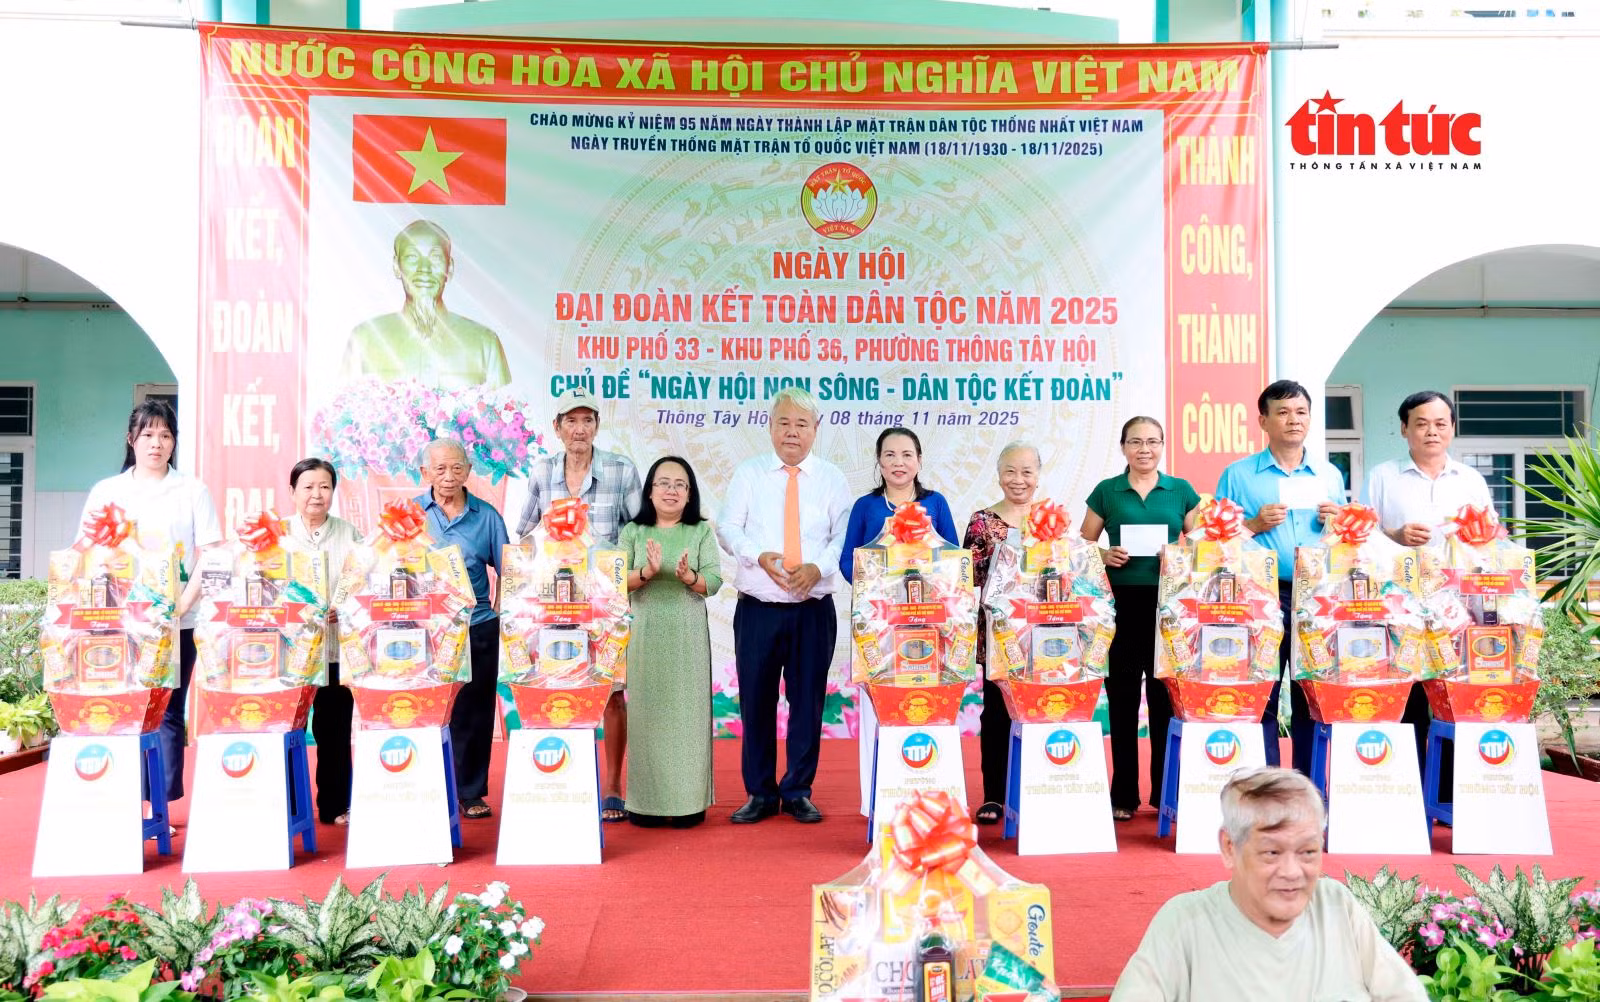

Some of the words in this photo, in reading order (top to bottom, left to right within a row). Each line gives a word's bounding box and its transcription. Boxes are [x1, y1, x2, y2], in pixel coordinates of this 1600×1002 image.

[229, 38, 356, 80] NƯỚC
[371, 44, 496, 89] CỘNG
[511, 47, 602, 88] HÒA
[616, 52, 676, 90] XÃ
[691, 54, 763, 97] HỘI
[779, 51, 867, 93] CHỦ
[883, 54, 1018, 94] NGHĨA
[1032, 54, 1123, 101] VIỆT
[1137, 59, 1239, 94] NAM
[530, 113, 568, 127] CHÀO
[572, 112, 614, 128] MỪNG
[617, 111, 635, 129] KỶ
[639, 114, 676, 132] NIỆM
[679, 118, 696, 131] 95
[700, 115, 732, 131] NĂM
[736, 115, 774, 132] NGÀY
[777, 116, 823, 133] THÀNH
[826, 116, 851, 135] LẬP
[856, 117, 886, 136] MẶT
[889, 117, 925, 136] TRẬN
[929, 117, 960, 133] DÂN
[962, 117, 987, 136] TỘC
[991, 114, 1036, 133] THỐNG
[1040, 115, 1075, 133] NHẤT
[1079, 117, 1109, 135] VIỆT
[1112, 119, 1144, 132] NAM
[571, 134, 608, 150] NGÀY
[670, 134, 716, 153] THỐNG
[720, 137, 750, 155] MẶT
[754, 137, 791, 156] TRẬN
[794, 136, 812, 153] TỔ
[815, 136, 851, 156] QUỐC
[856, 138, 884, 157] VIỆT
[889, 141, 920, 155] NAM
[924, 141, 1008, 157] (18/11/1930
[1020, 142, 1103, 157] 18/11/2025)
[1177, 125, 1255, 186] THÀNH
[773, 247, 848, 280] NGÀY
[858, 246, 905, 286] HỘI
[1180, 213, 1253, 281] CÔNG,
[212, 289, 294, 353] ĐOÀN
[555, 292, 604, 328] ĐẠI
[613, 287, 692, 323] ĐOÀN
[702, 284, 754, 323] KẾT
[762, 289, 836, 324] TOÀN
[846, 289, 905, 324] DÂN
[913, 290, 967, 331] TỘC
[976, 290, 1041, 325] NĂM
[1050, 297, 1118, 325] 2025
[577, 335, 620, 360] KHU
[626, 329, 668, 360] PHỐ
[675, 337, 700, 361] 33
[721, 337, 763, 361] KHU
[769, 329, 811, 362] PHỐ
[817, 337, 848, 364] 36,
[855, 333, 939, 362] PHƯỜNG
[945, 334, 1017, 362] THÔNG
[1019, 334, 1056, 362] TÂY
[1062, 334, 1097, 367] HỘI
[1178, 303, 1257, 364] THÀNH
[602, 368, 630, 399] ĐỀ
[718, 372, 756, 404] HỘI
[819, 372, 879, 401] SÔNG
[902, 372, 949, 401] DÂN
[955, 373, 997, 406] TỘC
[1004, 371, 1044, 401] KẾT
[223, 377, 280, 453] KẾT,
[656, 409, 707, 428] Thông
[712, 410, 741, 428] Tây
[747, 410, 769, 428] Hộ
[830, 411, 851, 426] 08
[857, 411, 904, 427] tháng
[912, 411, 929, 426] 11
[936, 411, 976, 426] năm
[978, 411, 1019, 426] 2025
[1182, 392, 1255, 454] CÔNG,
